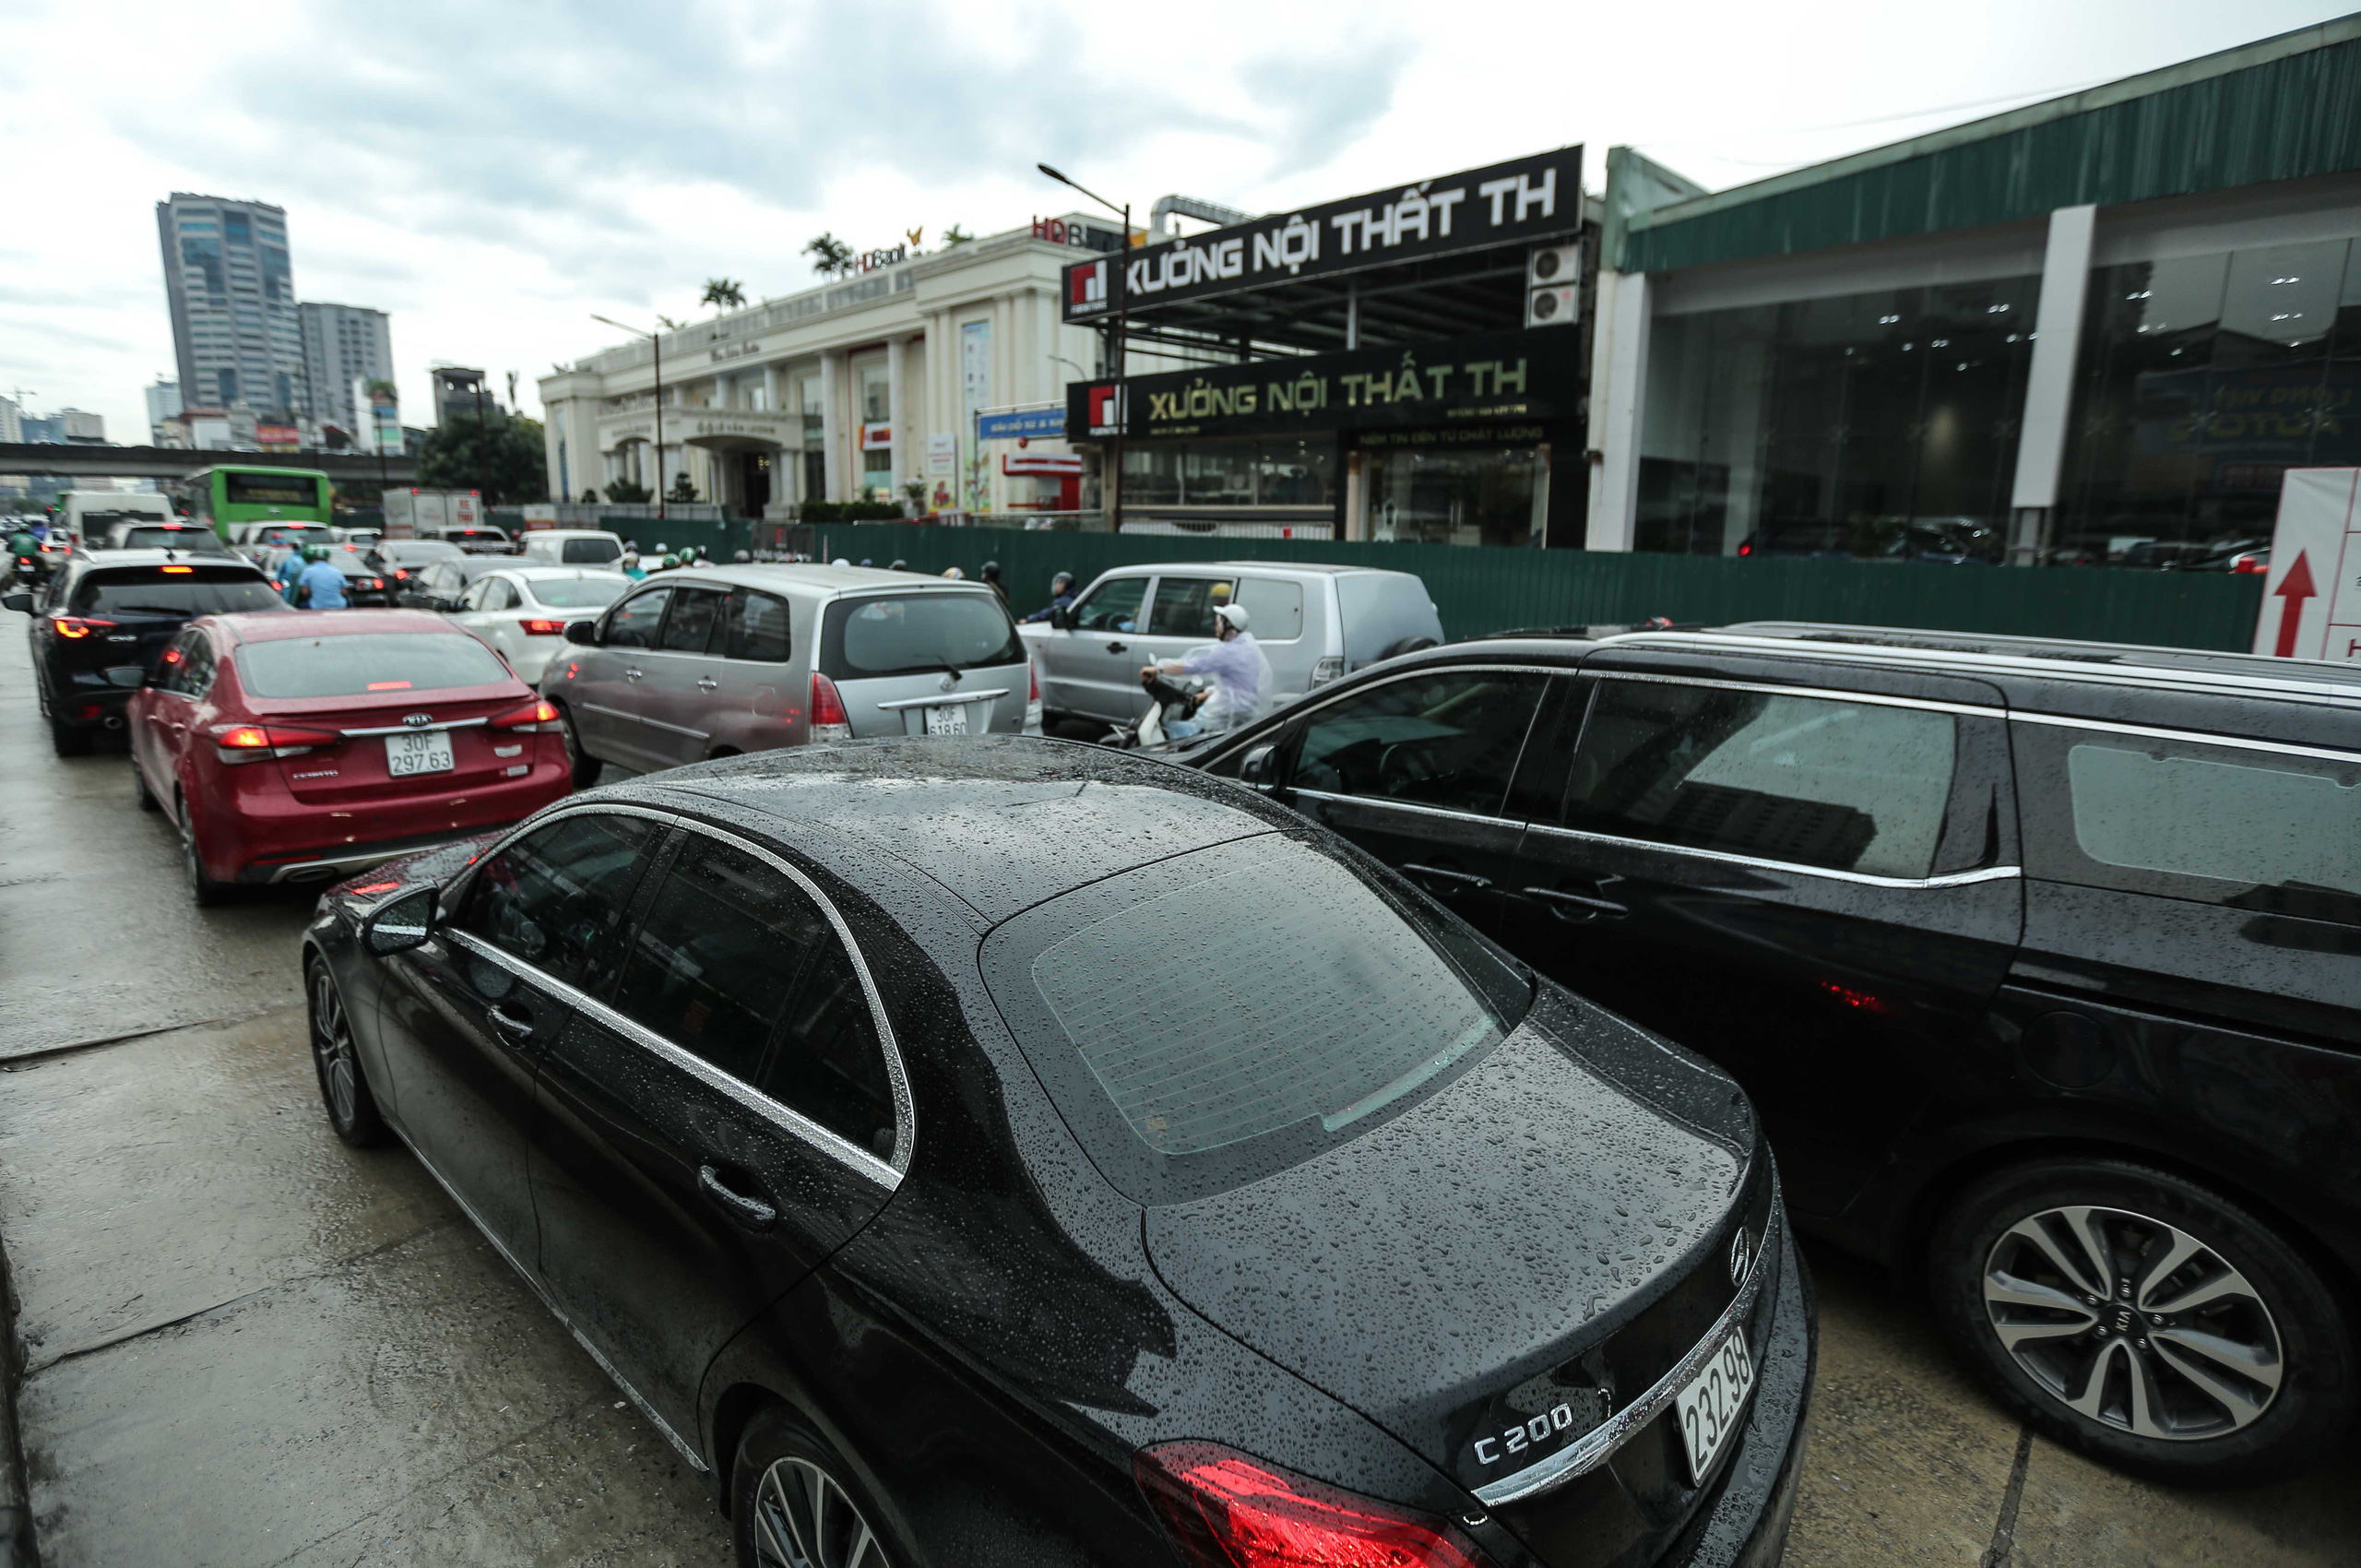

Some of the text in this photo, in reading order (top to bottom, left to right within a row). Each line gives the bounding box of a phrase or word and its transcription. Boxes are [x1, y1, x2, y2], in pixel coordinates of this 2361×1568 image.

[1032, 214, 1083, 247] HDB
[1125, 168, 1557, 295] XƯỞNG NỘI THẤT TH
[1149, 350, 1527, 421] XƯỞNG NỘI THẤT TH
[405, 715, 432, 727] KIA
[402, 733, 433, 753] 30F
[392, 751, 452, 773] 297.63
[2115, 1312, 2131, 1331] KIA
[1685, 1328, 1750, 1471] 232.98
[1474, 1402, 1572, 1466] C 200
